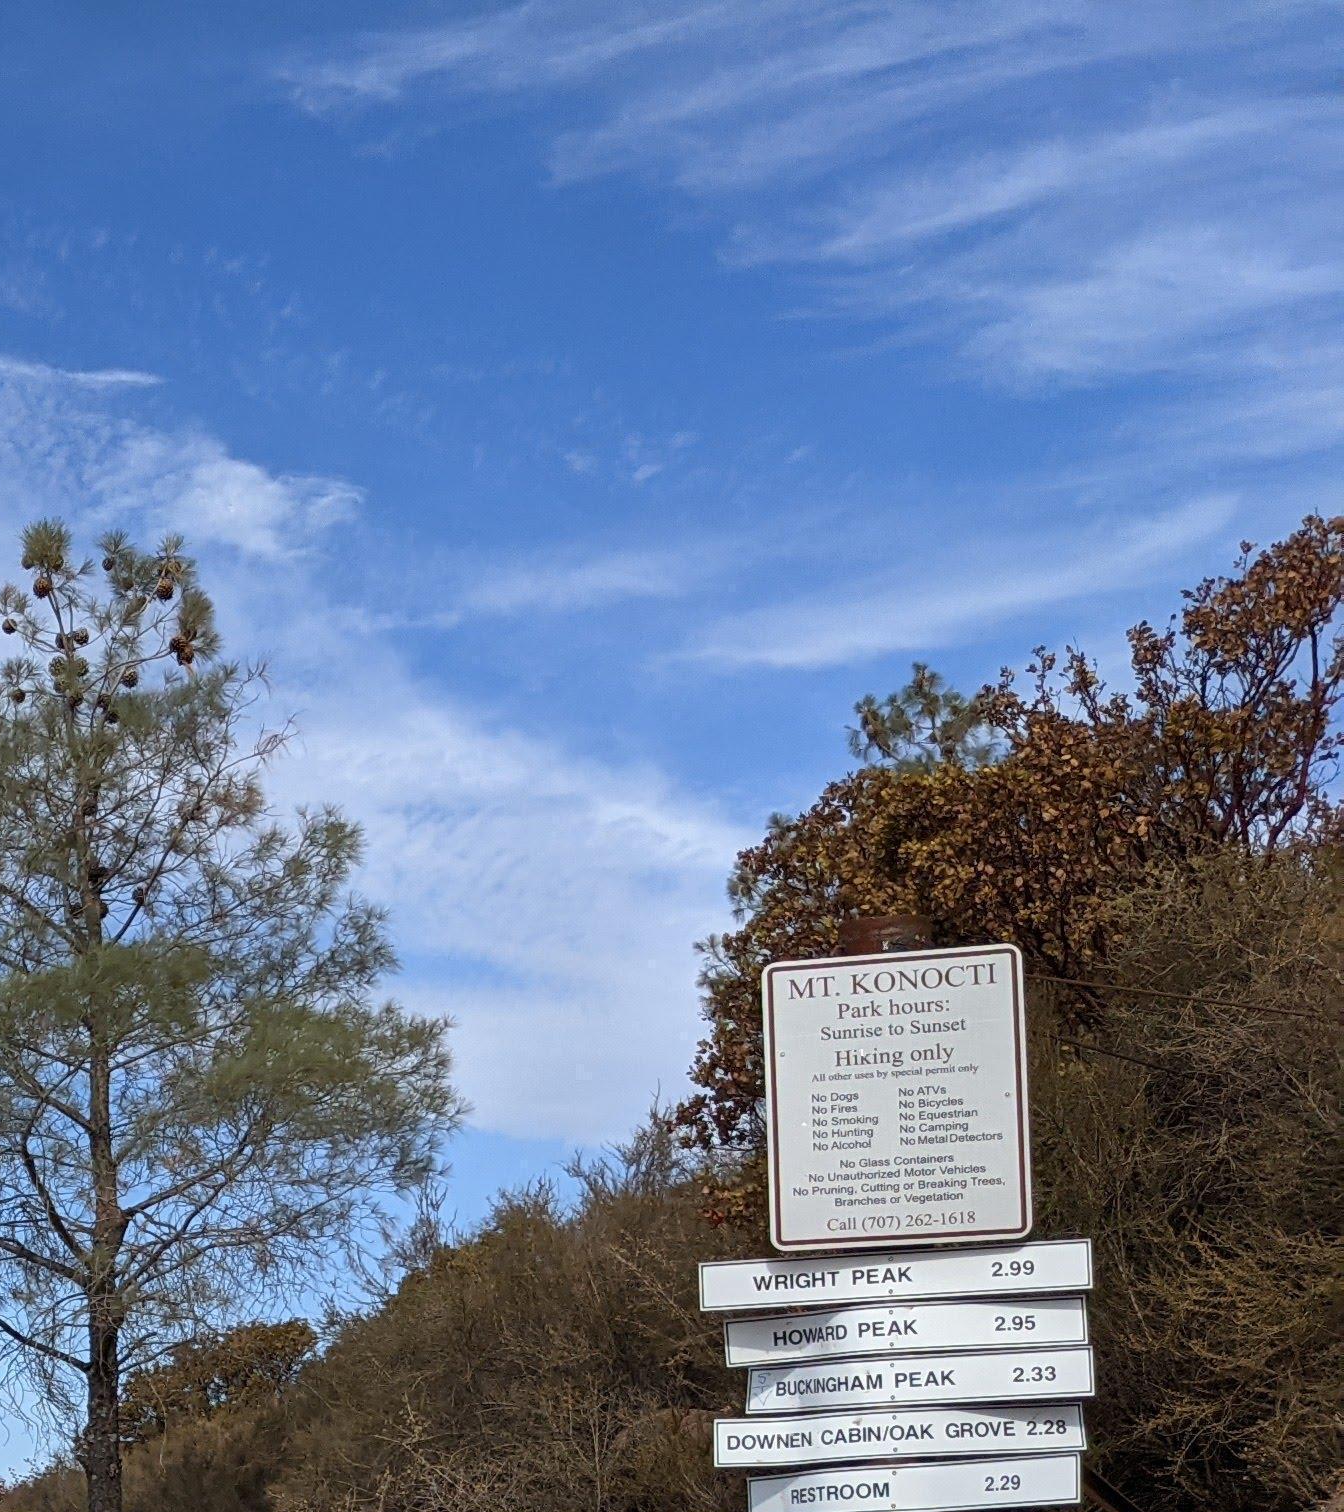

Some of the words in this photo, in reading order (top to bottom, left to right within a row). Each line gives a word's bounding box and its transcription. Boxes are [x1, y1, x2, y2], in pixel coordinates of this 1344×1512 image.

[788, 977, 840, 1000] MT.
[850, 963, 997, 995] KONOCTI
[837, 1002, 883, 1020] Park
[889, 999, 950, 1016] hours:
[820, 1024, 883, 1041] Sunrise
[888, 1022, 904, 1036] to
[910, 1019, 966, 1035] Sunset
[835, 1048, 902, 1067] Hiking
[911, 1044, 954, 1064] only
[812, 1074, 826, 1082] All
[828, 1072, 852, 1081] other
[854, 1071, 873, 1080] uses
[877, 1069, 888, 1080] by
[892, 1067, 922, 1078] special
[926, 1066, 955, 1077] permit
[958, 1064, 978, 1074] only
[812, 1093, 827, 1103] No
[830, 1091, 859, 1103] Dogs
[899, 1087, 914, 1097] No
[917, 1085, 946, 1096] ATVs
[812, 1105, 828, 1115] No
[831, 1104, 857, 1114] Fires
[899, 1099, 914, 1109] No
[918, 1097, 963, 1109] Bicycles
[812, 1117, 828, 1127] No
[831, 1115, 879, 1127] Smoking
[899, 1111, 915, 1121] No
[918, 1108, 978, 1122] Equestrian
[813, 1130, 828, 1139] No
[831, 1127, 873, 1139] Hunting
[900, 1123, 915, 1134] No
[918, 1121, 968, 1133] Camping
[813, 1141, 828, 1152] No
[831, 1139, 871, 1150] Alcohol
[900, 1136, 915, 1146] No
[840, 1159, 855, 1169] No
[859, 1157, 890, 1168] Glass
[894, 1154, 954, 1166] Containers
[809, 1173, 824, 1183] No
[828, 1169, 900, 1182] Unauthorized
[904, 1166, 936, 1177] Motor
[939, 1164, 986, 1175] Vehicles
[793, 1187, 809, 1197] No
[861, 1182, 900, 1195] Cutting
[903, 1181, 914, 1191] or
[918, 1178, 967, 1191] Breaking
[834, 1196, 886, 1207] Branches
[889, 1195, 900, 1205] or
[904, 1191, 963, 1205] Vegetation
[827, 1217, 856, 1231] Call
[862, 1215, 900, 1232] (707)
[905, 1211, 976, 1228] 262-1618
[753, 1271, 840, 1291] WRIGHT
[851, 1266, 912, 1285] PEAK
[991, 1260, 1035, 1278] 2.99
[773, 1325, 847, 1347] HOWARD
[857, 1319, 918, 1338] PEAK
[994, 1315, 1036, 1332] 2.95
[775, 1373, 883, 1397] BUCKINGHAM
[894, 1370, 955, 1389] PEAK
[1013, 1366, 1056, 1383] 2.33
[727, 1432, 812, 1450] DOWNEN
[820, 1424, 934, 1446] CABIN/OAK
[945, 1422, 1015, 1438] GROVE
[1027, 1420, 1066, 1436] 2.28
[791, 1483, 890, 1504] RESTROOM
[984, 1476, 1021, 1492] 2.29
